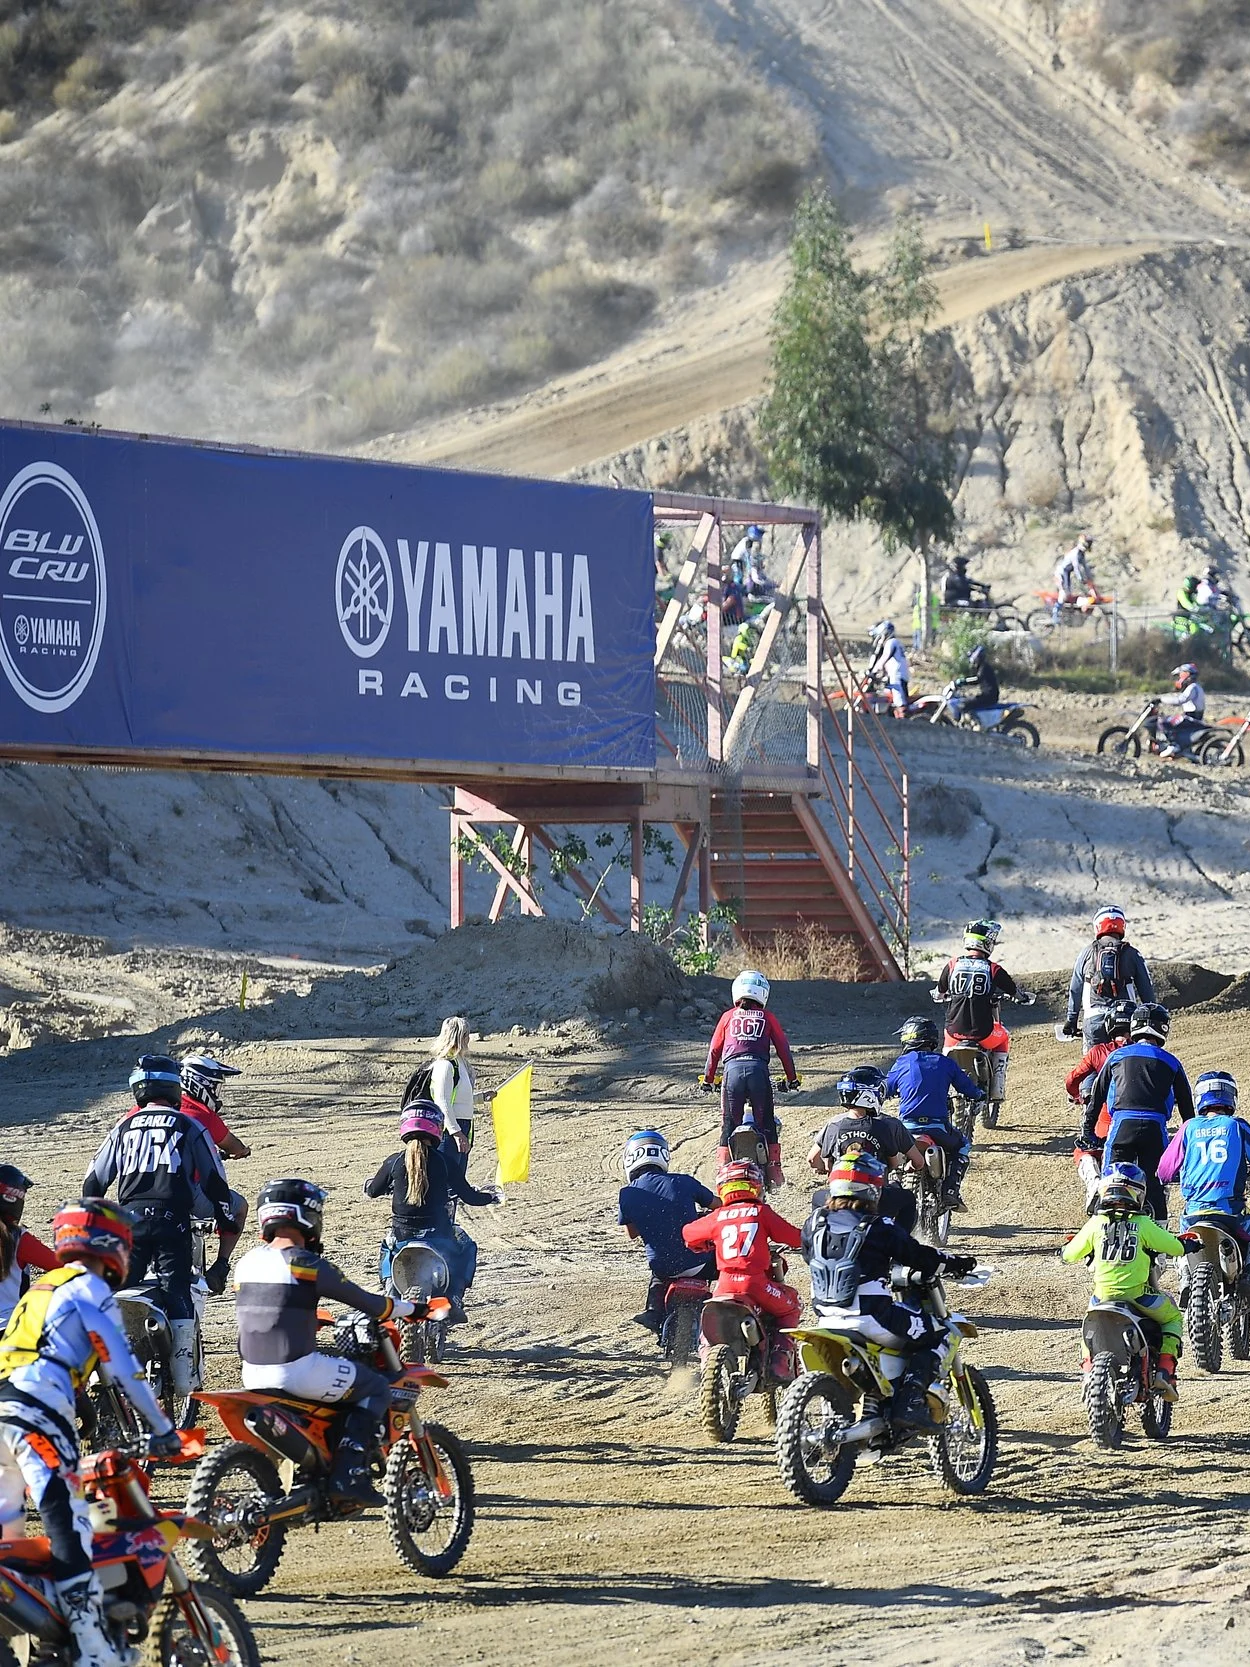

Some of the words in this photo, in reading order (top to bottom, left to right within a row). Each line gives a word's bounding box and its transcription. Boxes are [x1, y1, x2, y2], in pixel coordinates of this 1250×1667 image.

[3, 528, 85, 555] BLU
[8, 556, 90, 583] CRU
[397, 538, 595, 664] YAMAHA
[30, 617, 81, 647] YAMAHA
[19, 646, 77, 657] RACING
[358, 669, 581, 706] RACING
[952, 972, 988, 998] 178
[730, 1017, 766, 1038] 867
[837, 1130, 881, 1152] ASTHOUSE
[1195, 1126, 1227, 1138] GREENE
[122, 1128, 184, 1176] 864
[1194, 1139, 1228, 1166] 16
[716, 1206, 759, 1222] KOTA
[721, 1222, 759, 1260] 27
